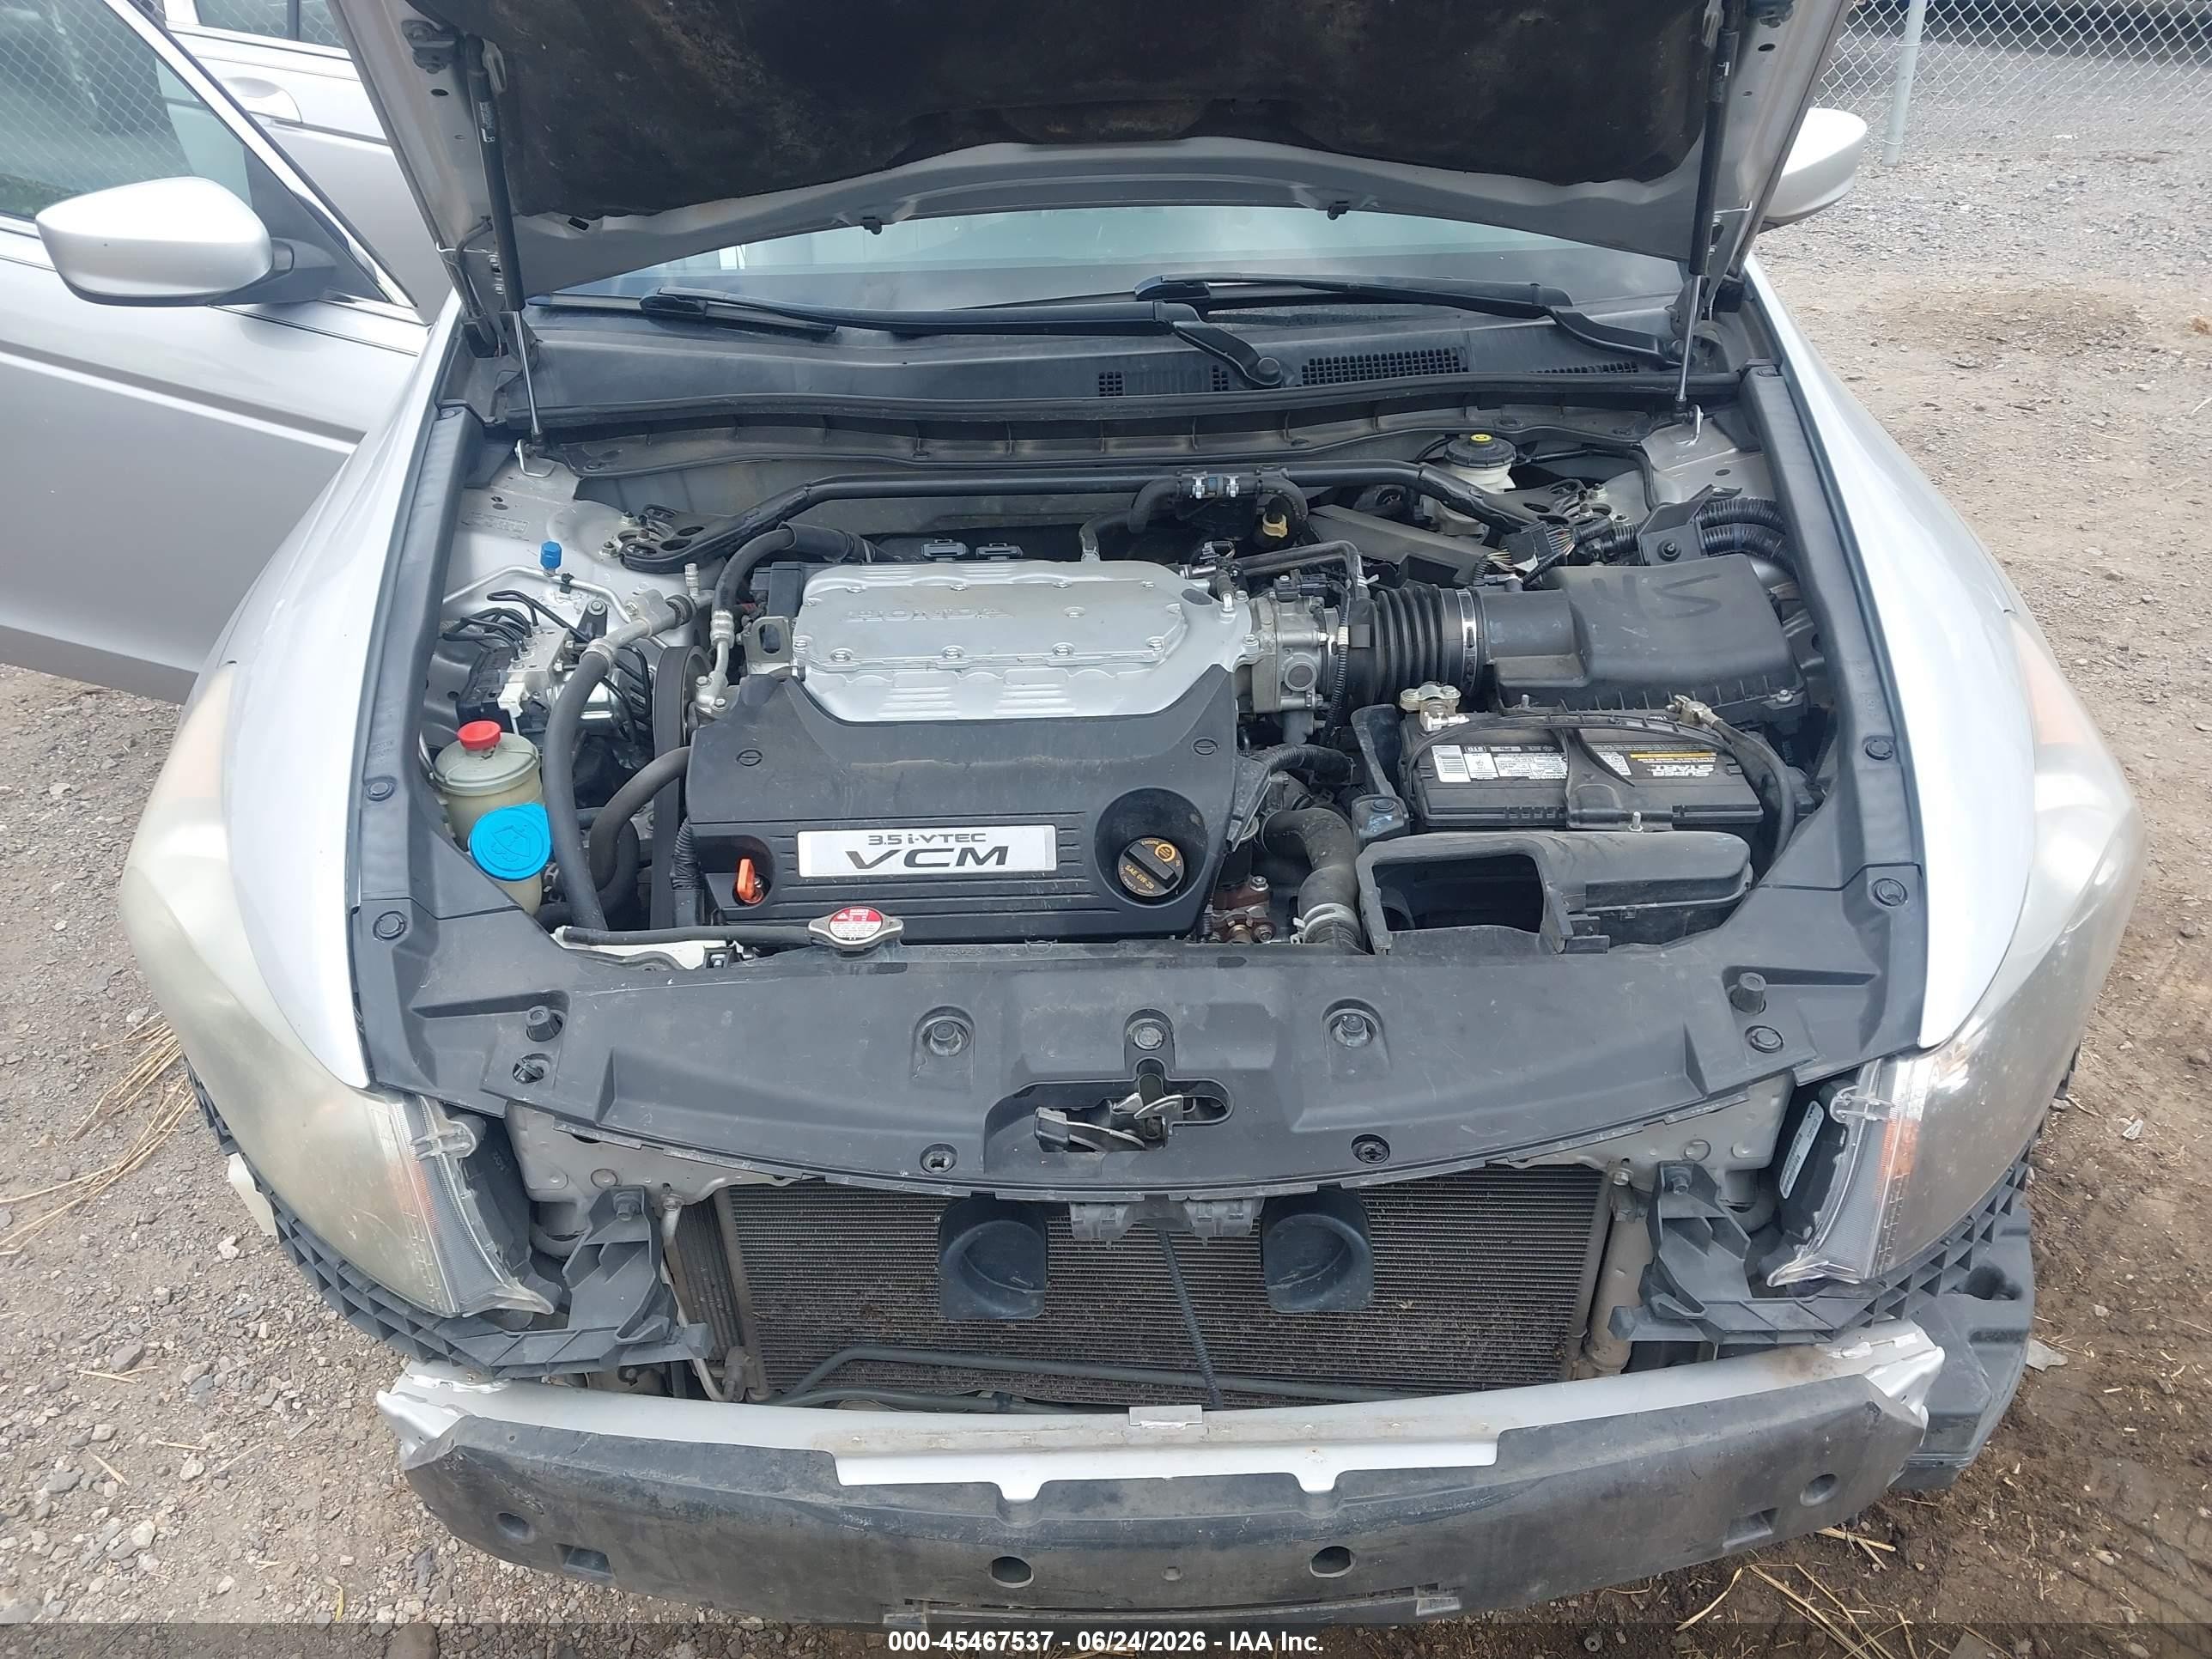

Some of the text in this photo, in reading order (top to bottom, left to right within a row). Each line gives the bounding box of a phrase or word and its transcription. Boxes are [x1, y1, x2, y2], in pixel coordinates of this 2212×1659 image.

[868, 833, 987, 846] 3.5 i-VTEC
[845, 846, 1009, 870] VCM
[1125, 865, 1138, 877] SAE
[1136, 872, 1155, 890] 0W-20
